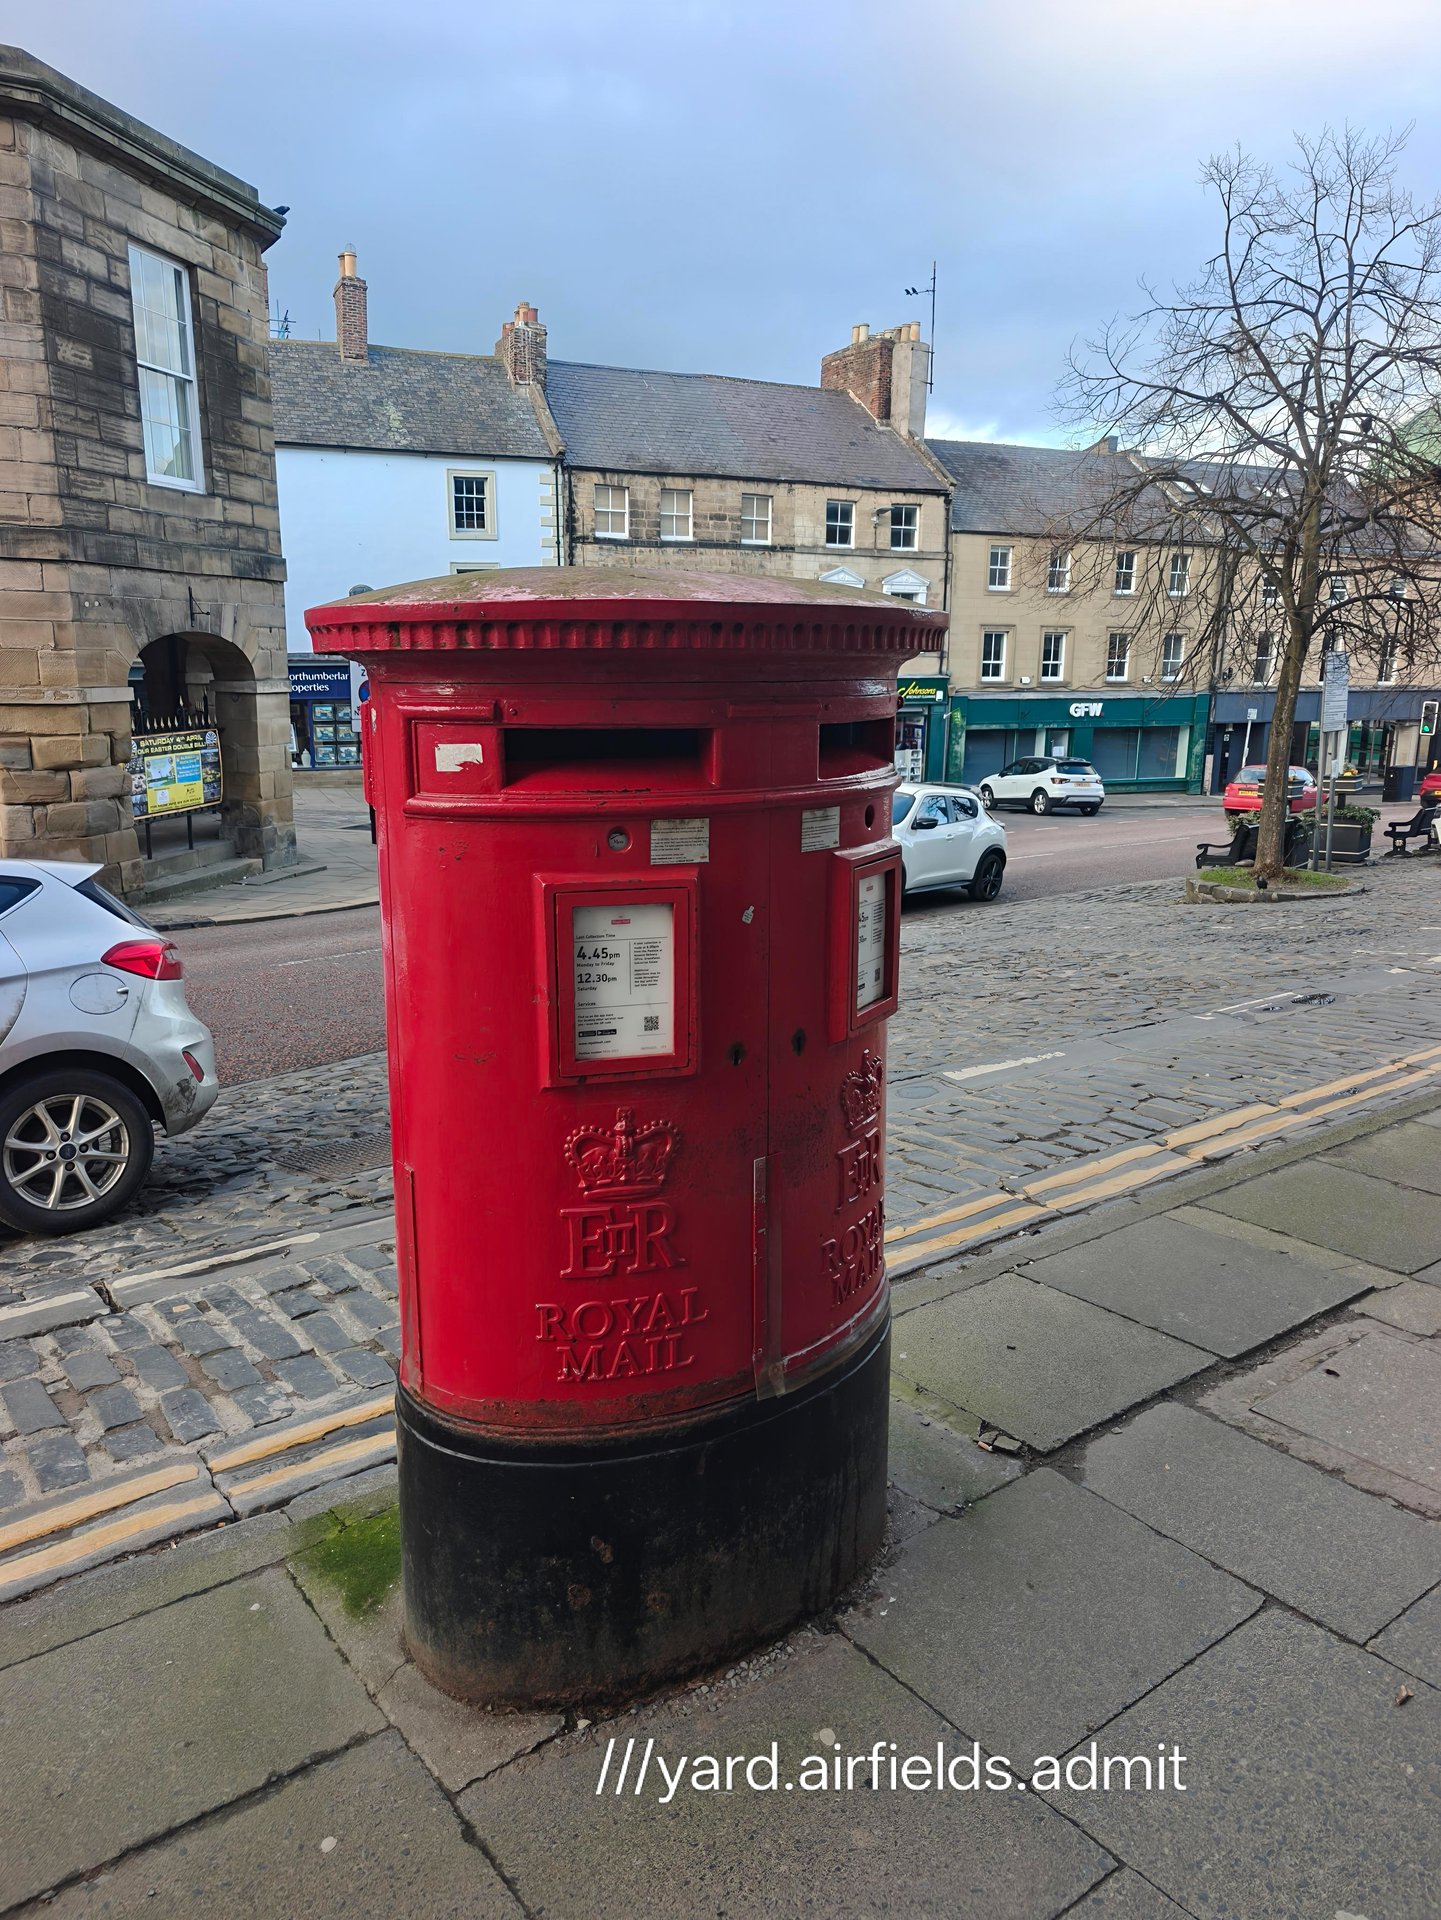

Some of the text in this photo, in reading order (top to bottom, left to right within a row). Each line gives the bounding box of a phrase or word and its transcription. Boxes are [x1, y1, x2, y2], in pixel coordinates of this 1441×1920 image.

[289, 671, 349, 681] orthumberla
[291, 683, 330, 693] operties
[1069, 702, 1103, 717] GFW
[140, 737, 174, 747] SATURDAY
[186, 734, 203, 742] APRIL
[150, 745, 172, 753] EASTER
[173, 743, 193, 751] DOUBLE
[576, 945, 621, 960] 4.45pm
[577, 972, 618, 984] 12.30pm
[534, 1286, 709, 1343] ROYAL
[556, 1332, 695, 1383] MAIL
